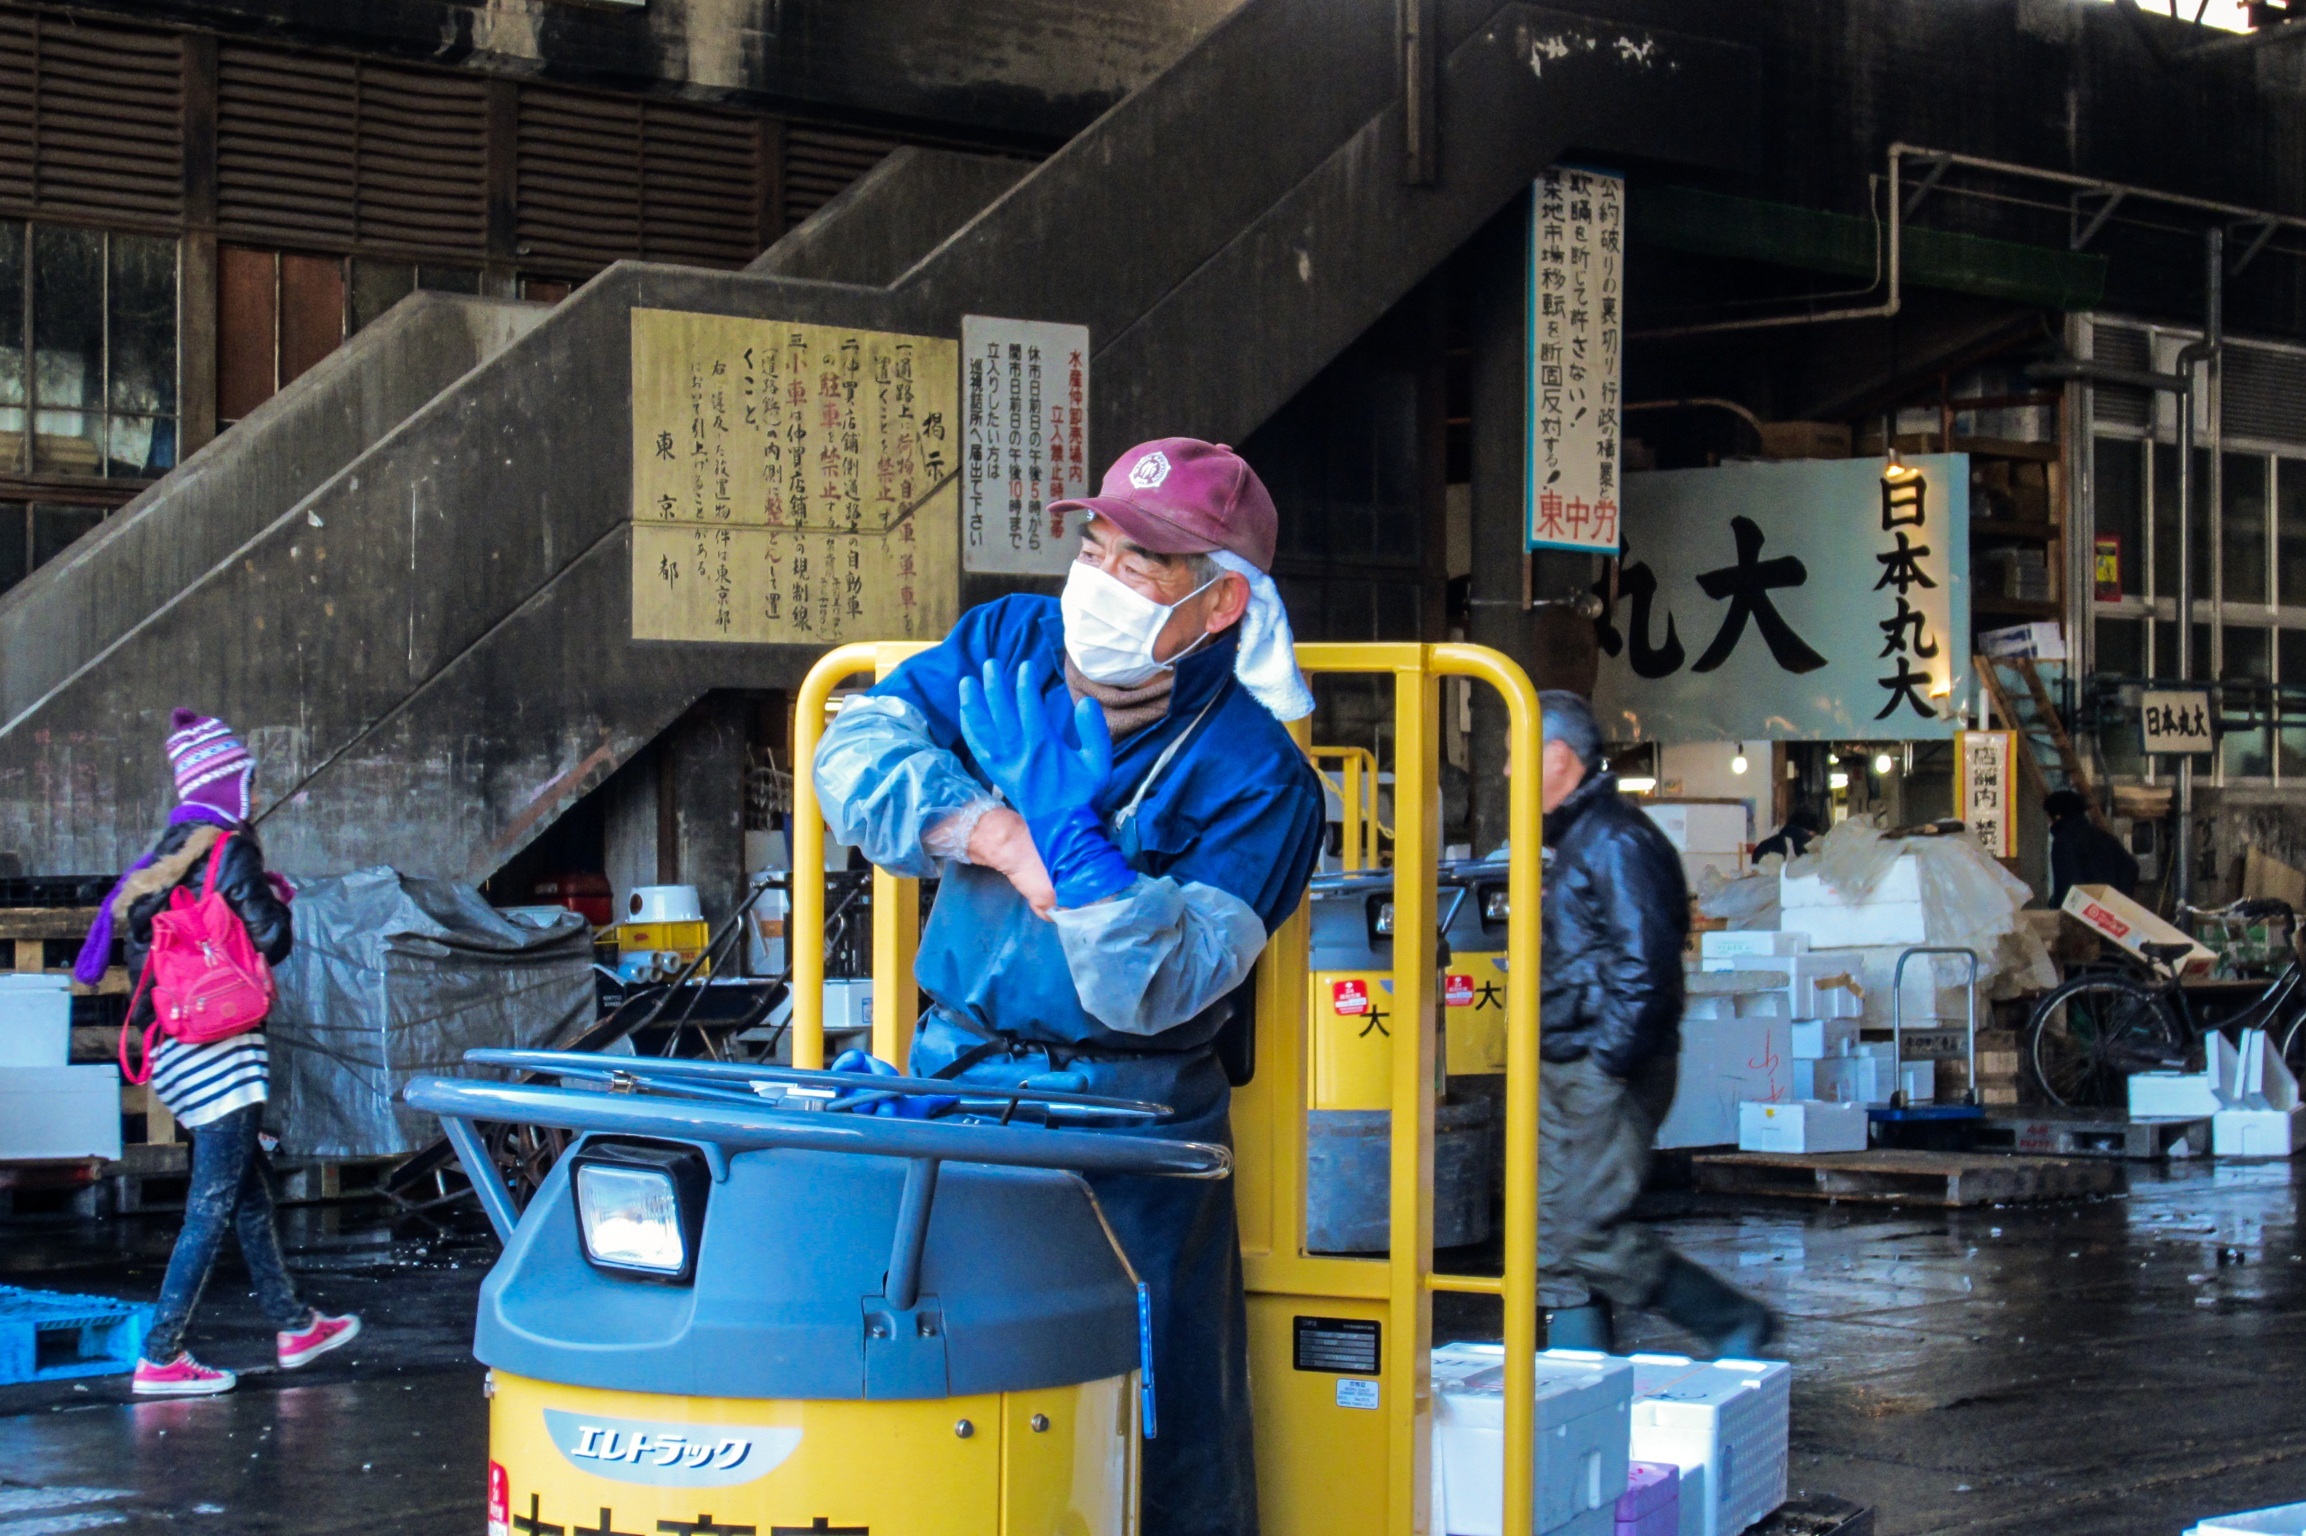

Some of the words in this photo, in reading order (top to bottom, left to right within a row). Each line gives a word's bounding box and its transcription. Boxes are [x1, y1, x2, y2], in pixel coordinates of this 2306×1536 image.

[987, 342, 1000, 479] 立入りしたい方は
[655, 430, 679, 590] 東京都
[1536, 489, 1618, 544] 東中労
[1873, 474, 1939, 720] 日本丸大
[2146, 703, 2208, 737] 日本丸大
[571, 1424, 752, 1470] エレトラック
